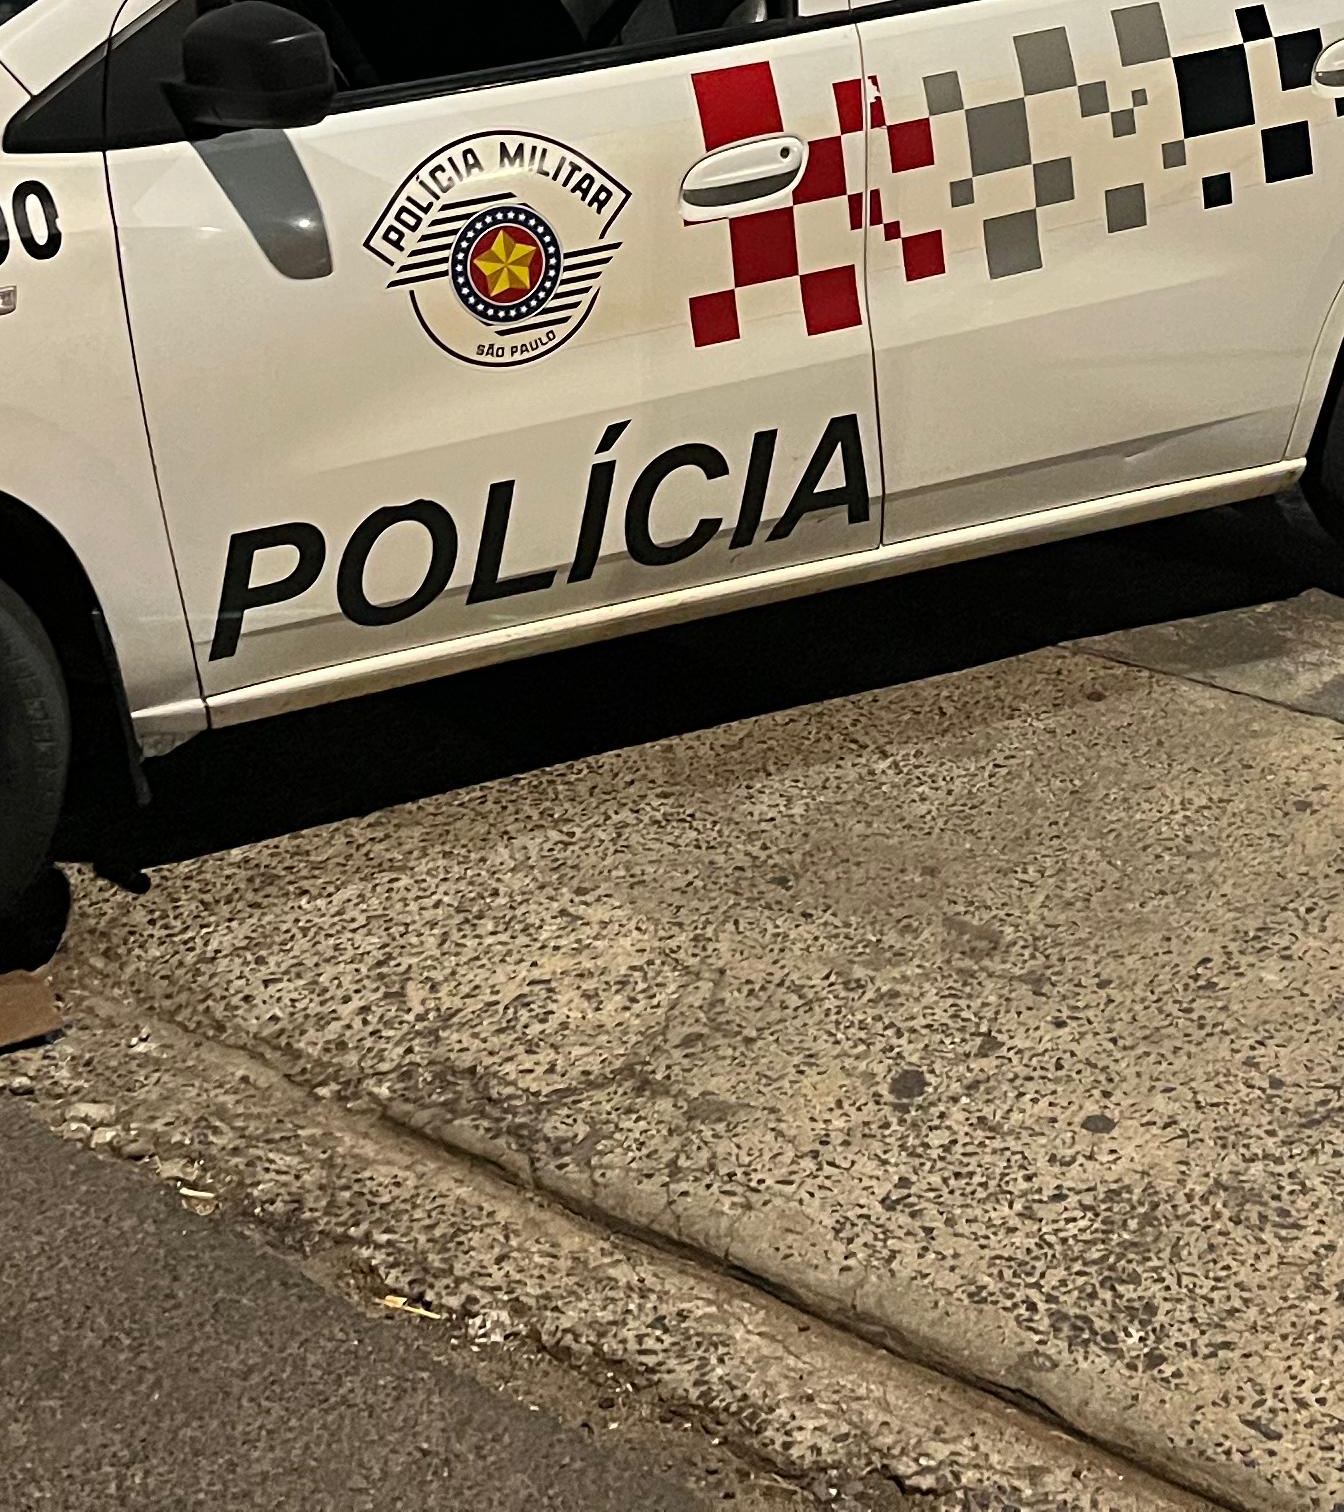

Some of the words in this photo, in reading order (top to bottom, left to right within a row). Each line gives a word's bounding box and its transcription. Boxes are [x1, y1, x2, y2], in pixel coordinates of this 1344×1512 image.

[381, 147, 484, 253] POLÍCIA
[498, 141, 615, 215] MILITAR
[475, 342, 506, 358] SÃO
[510, 329, 557, 358] PAULO
[208, 413, 871, 662] POLÍCIA
